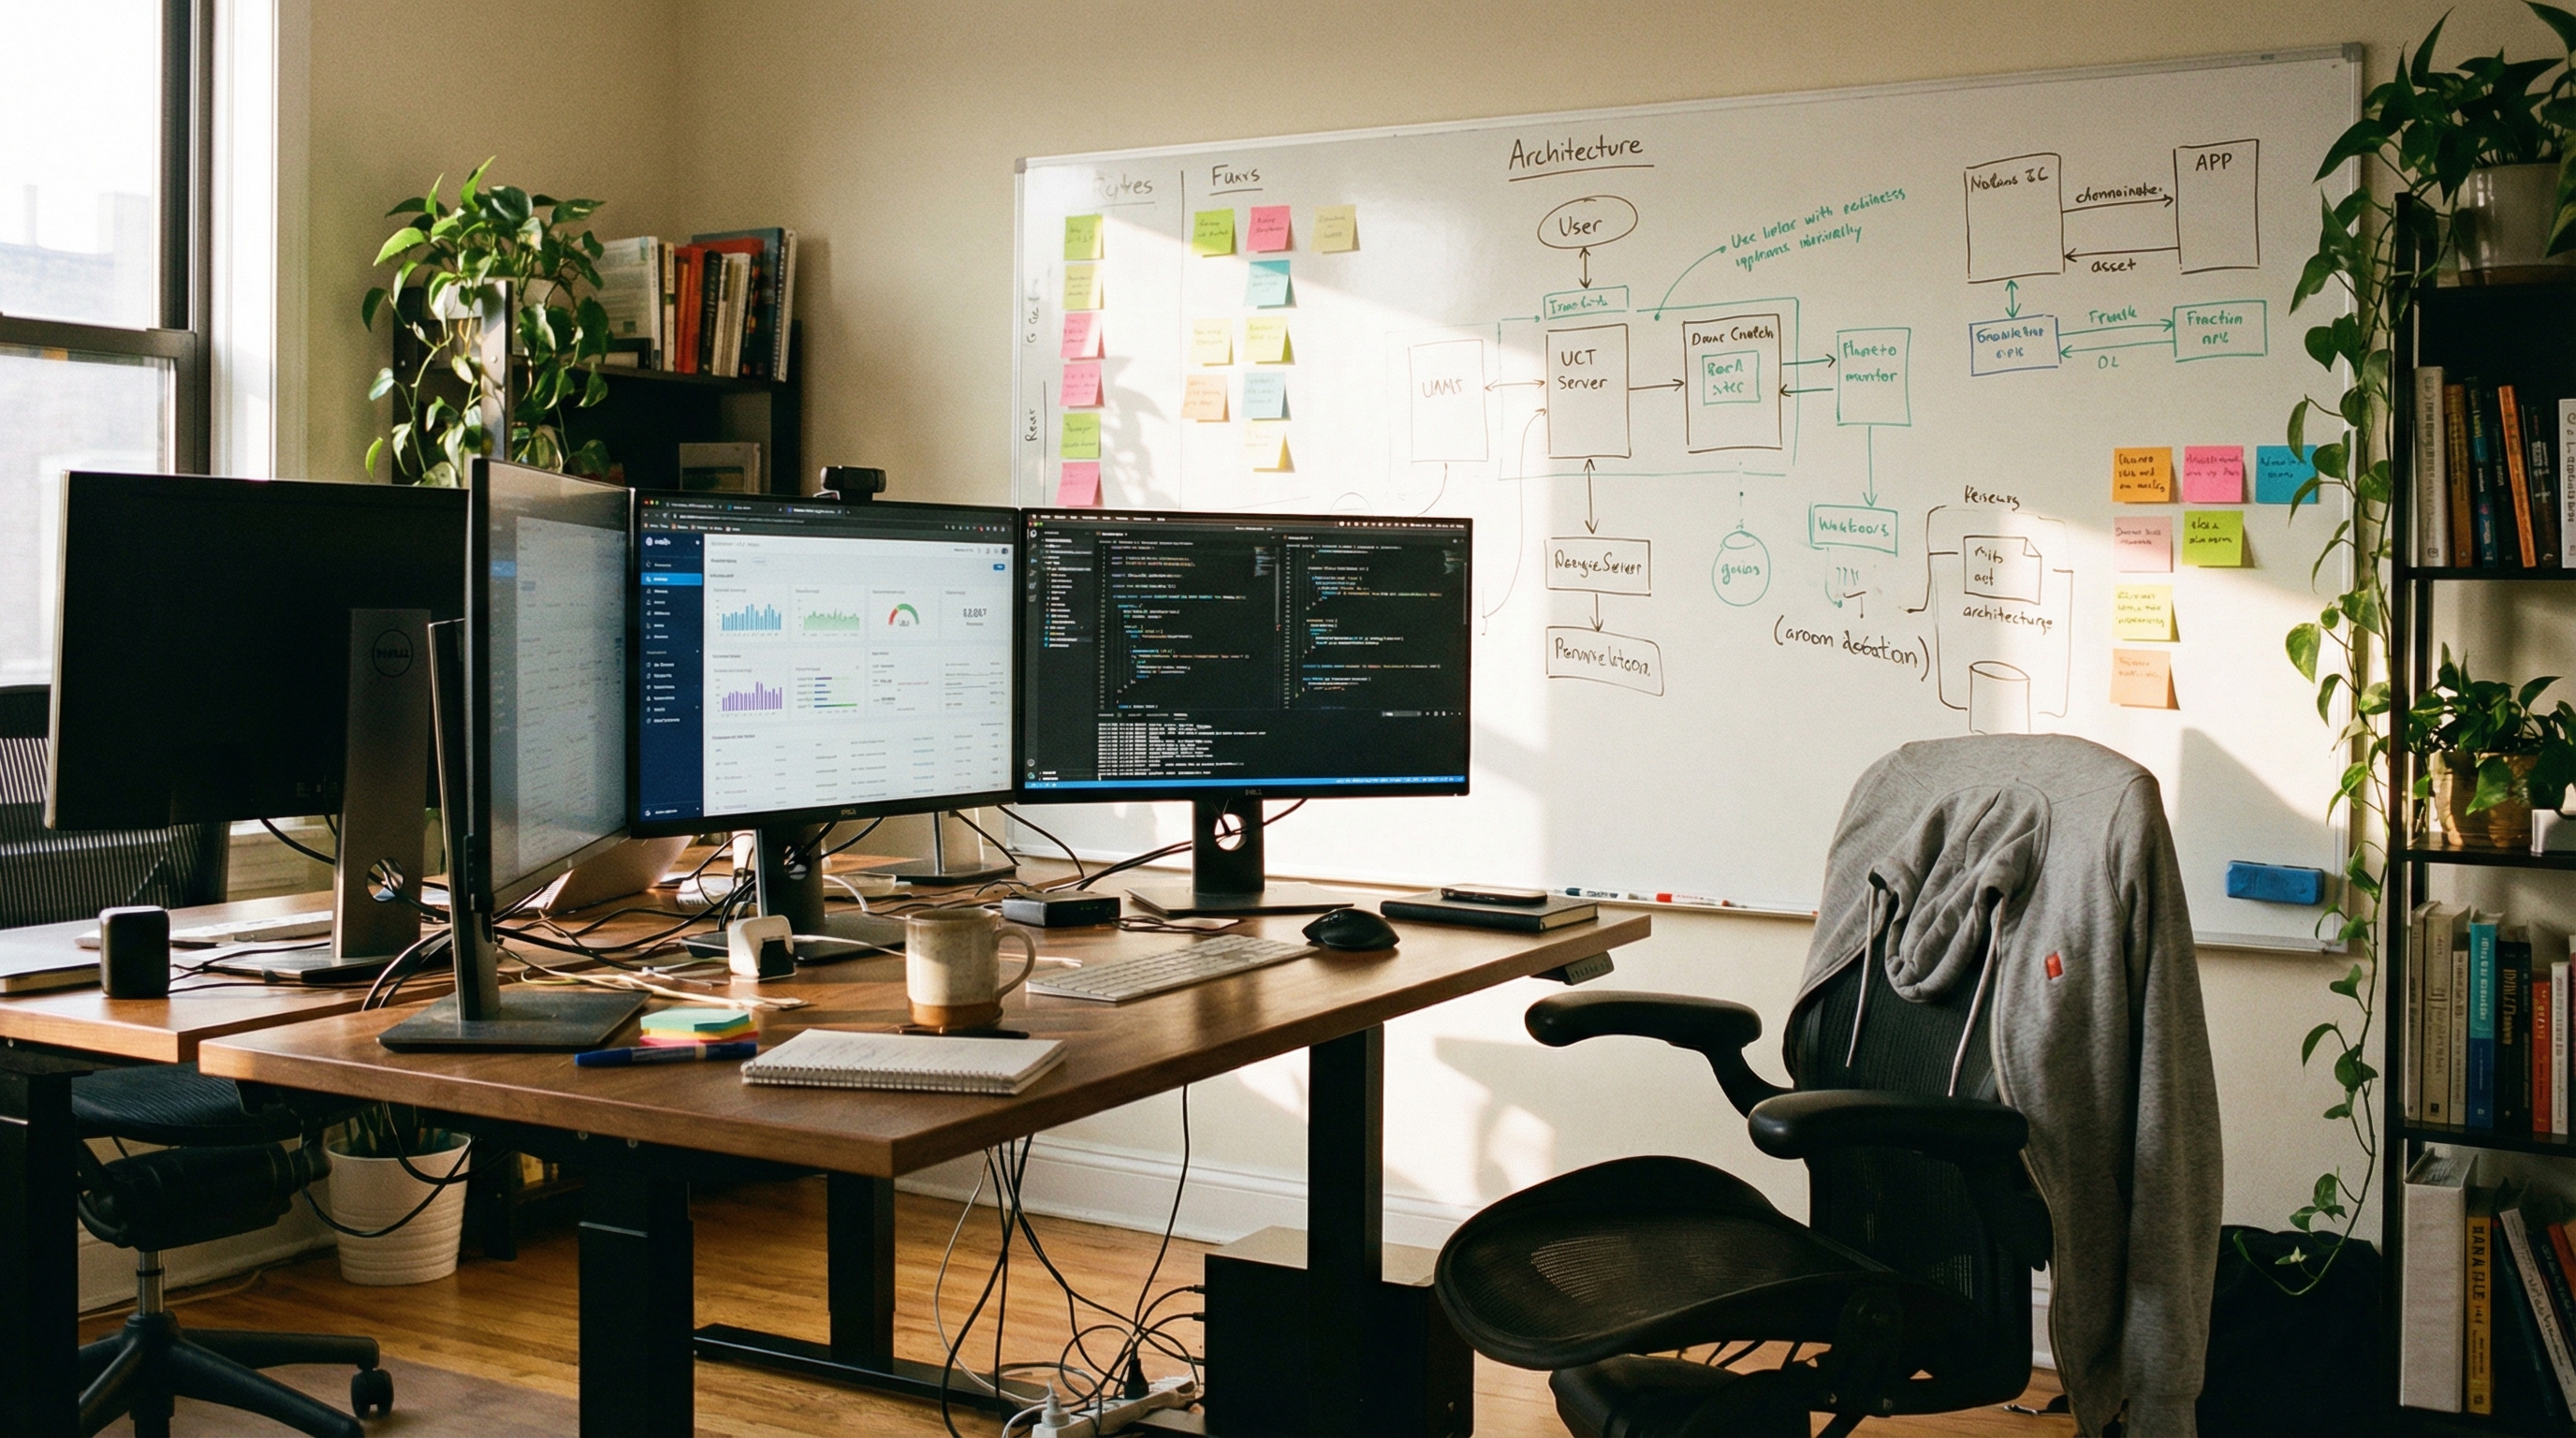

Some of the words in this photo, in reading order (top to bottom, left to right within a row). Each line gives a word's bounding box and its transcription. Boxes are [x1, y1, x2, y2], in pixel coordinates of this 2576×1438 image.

[1509, 134, 1644, 170] Architecture
[2195, 152, 2232, 171] APP
[1805, 205, 1833, 225] with
[1559, 215, 1603, 237] User
[2091, 257, 2137, 272] asset
[1560, 348, 1597, 367] UCT
[1558, 375, 1608, 390] Server
